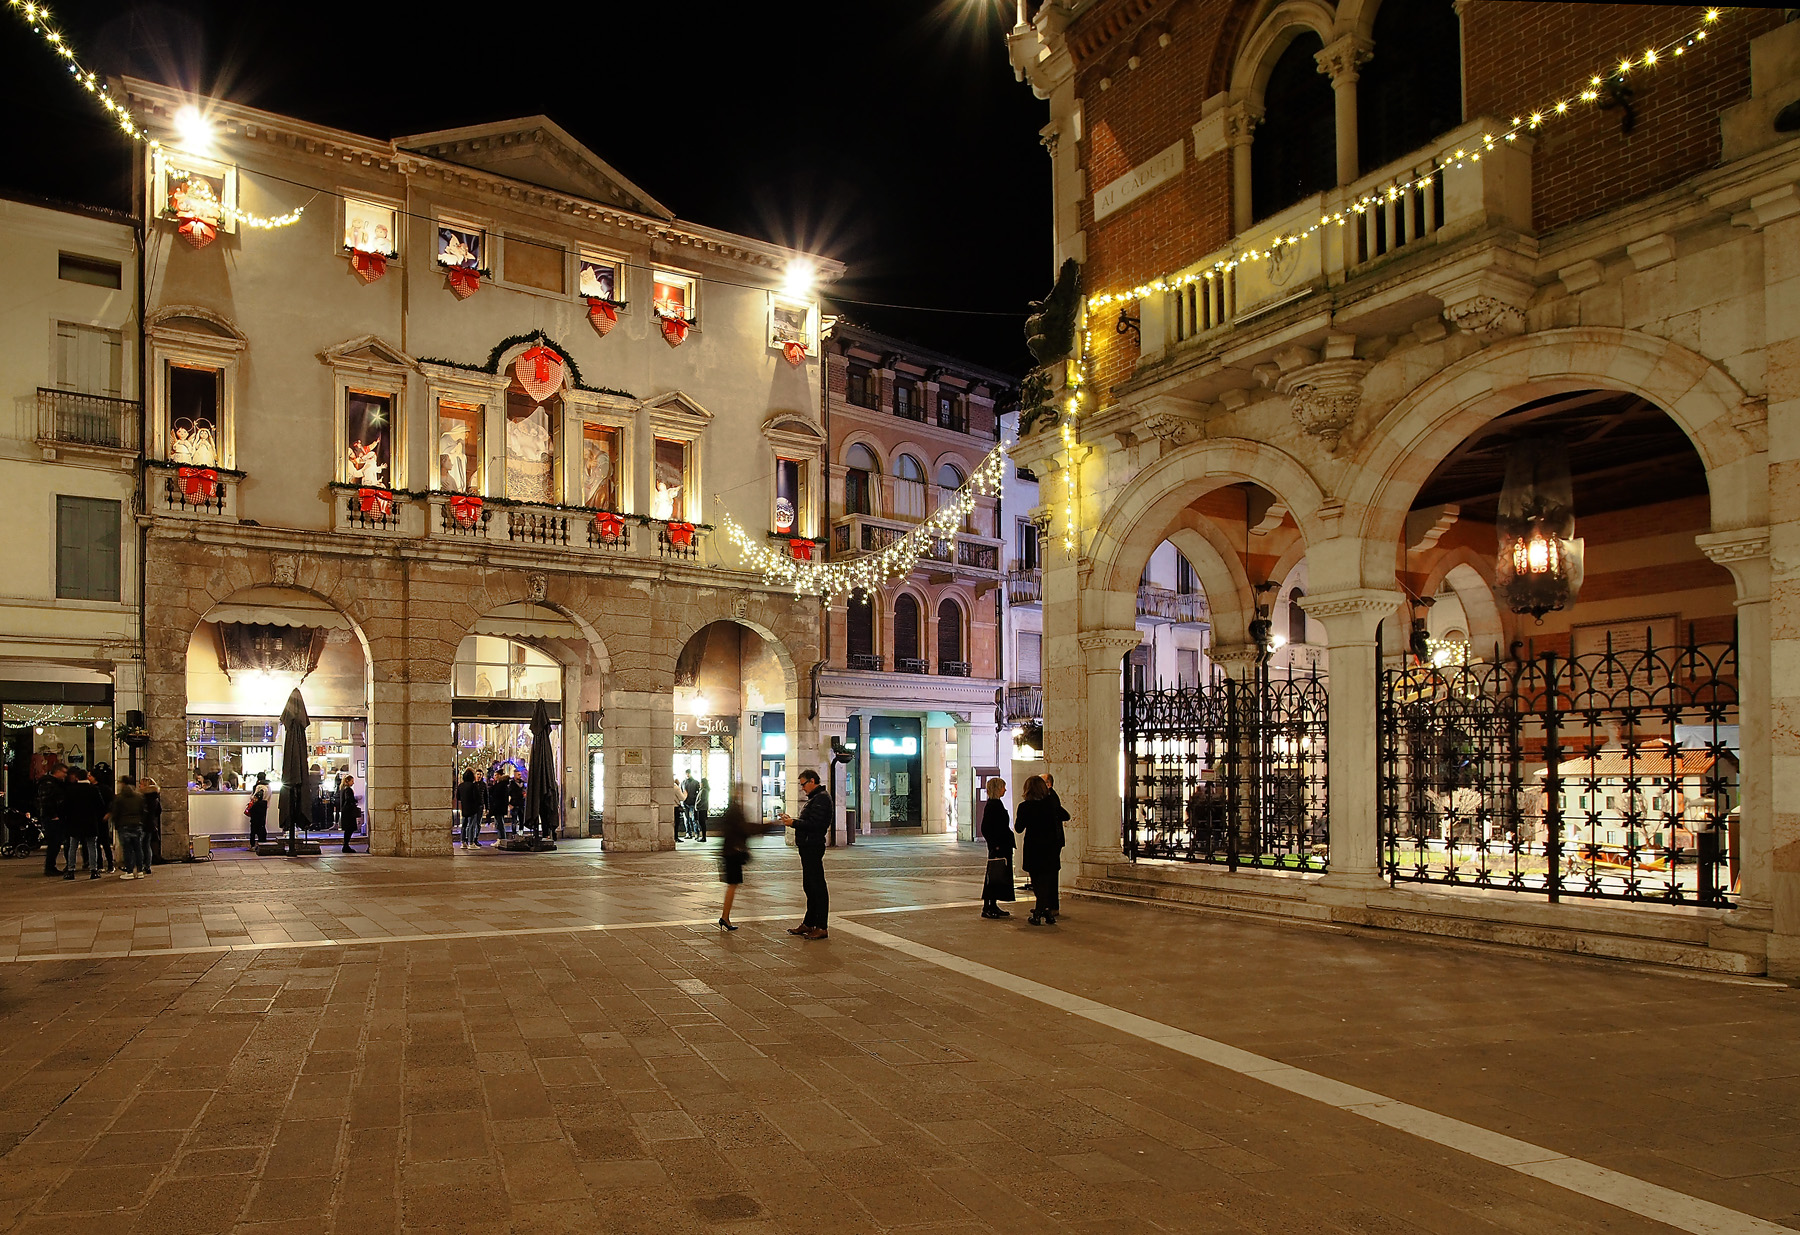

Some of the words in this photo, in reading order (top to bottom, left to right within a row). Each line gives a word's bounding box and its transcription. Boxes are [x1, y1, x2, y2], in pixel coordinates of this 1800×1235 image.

[1101, 191, 1114, 210] AI
[1121, 153, 1175, 196] CADUTI
[696, 717, 731, 735] Stella
